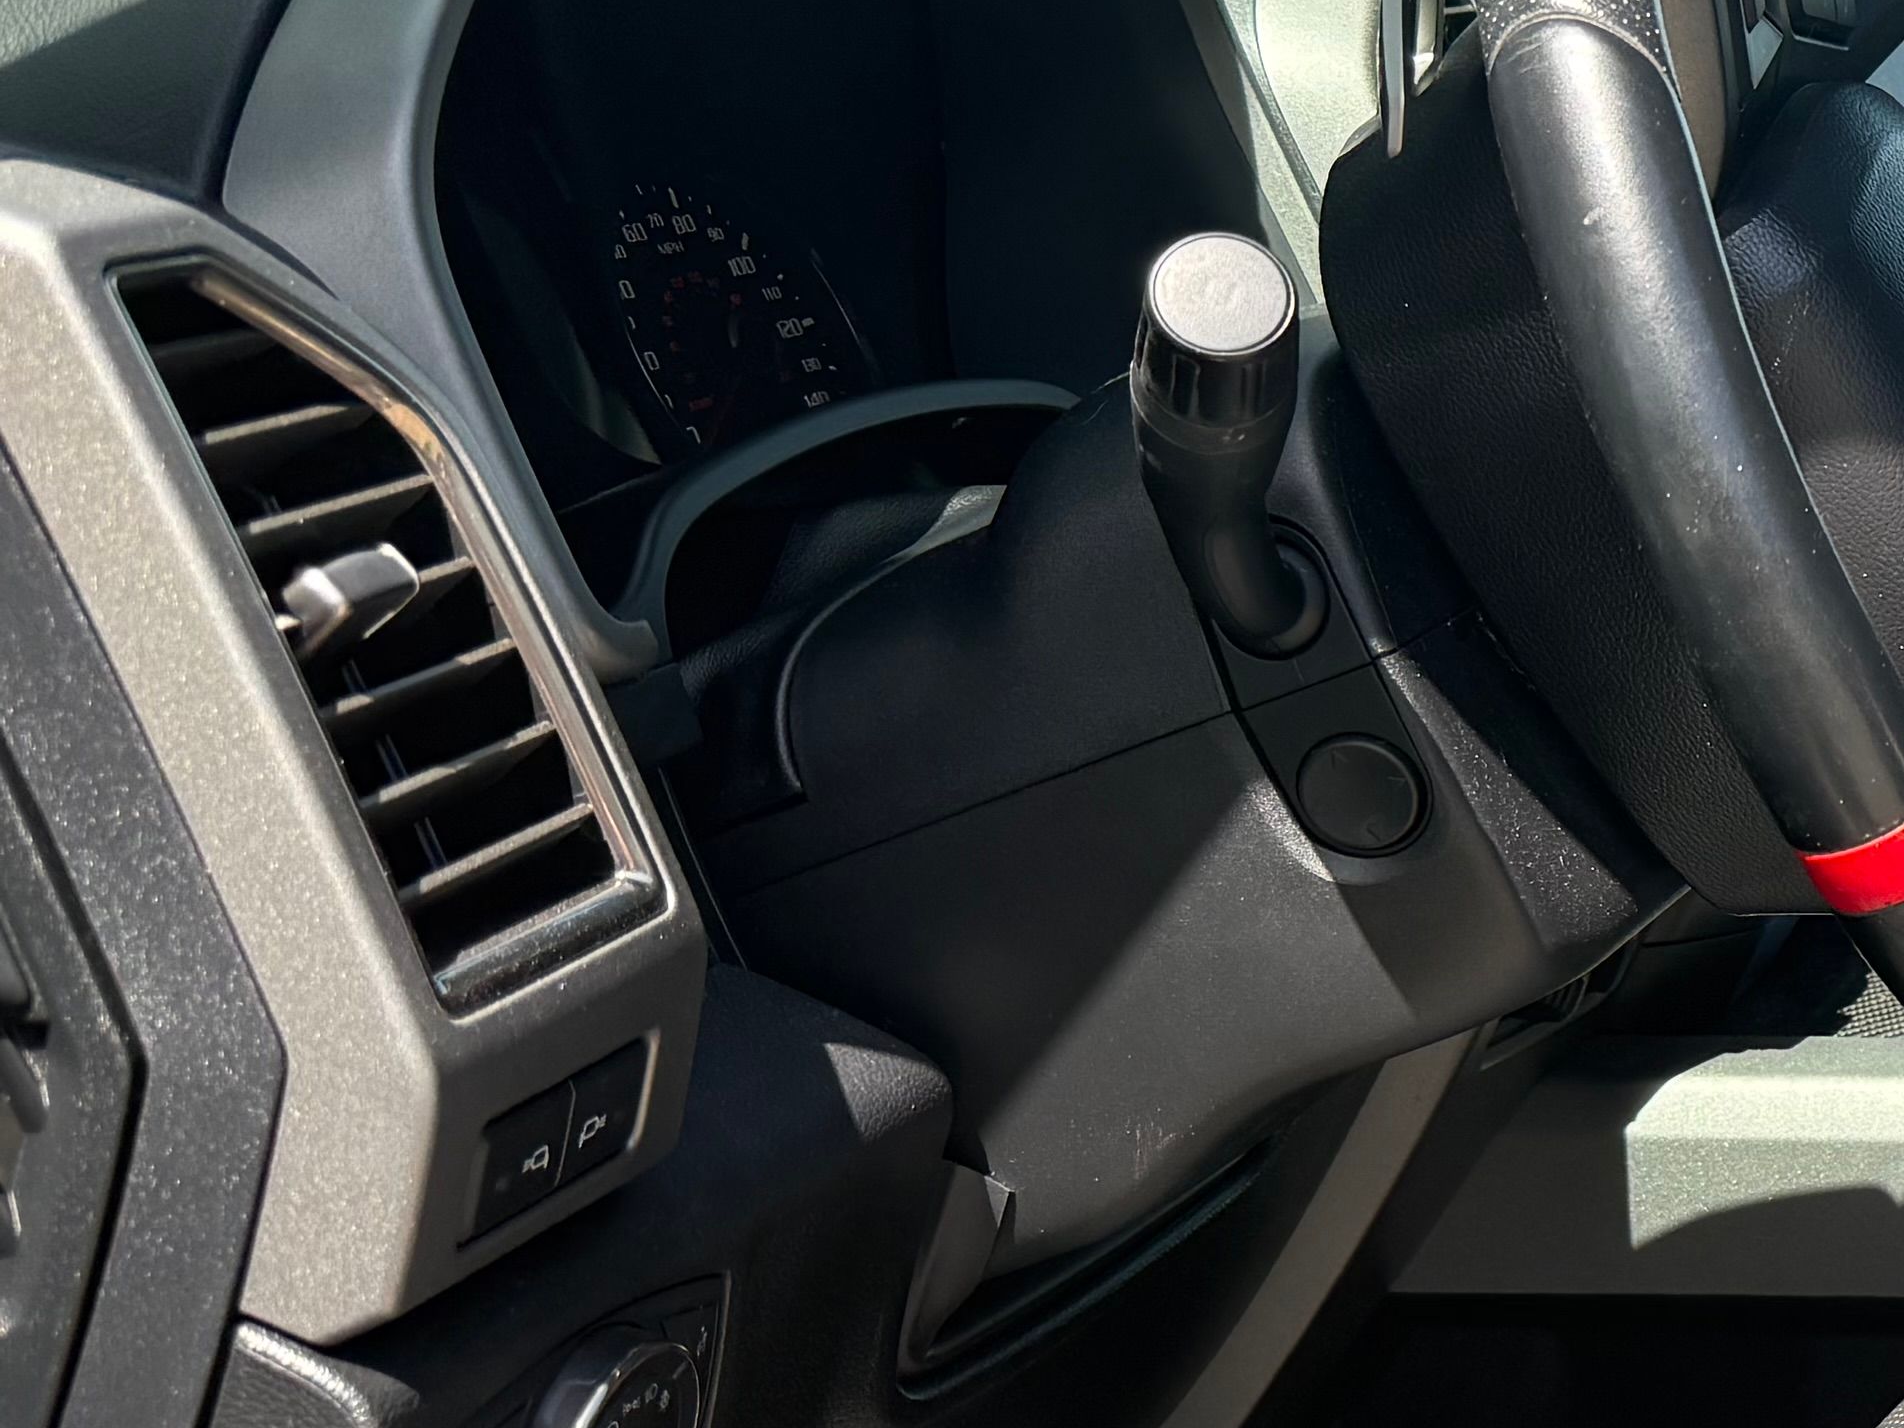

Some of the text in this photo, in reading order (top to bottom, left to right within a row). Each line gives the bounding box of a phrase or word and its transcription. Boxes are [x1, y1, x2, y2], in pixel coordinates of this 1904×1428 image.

[622, 223, 648, 243] 60
[672, 214, 697, 235] 80
[727, 256, 756, 277] 100
[762, 286, 783, 301] 110
[776, 318, 804, 339] 120
